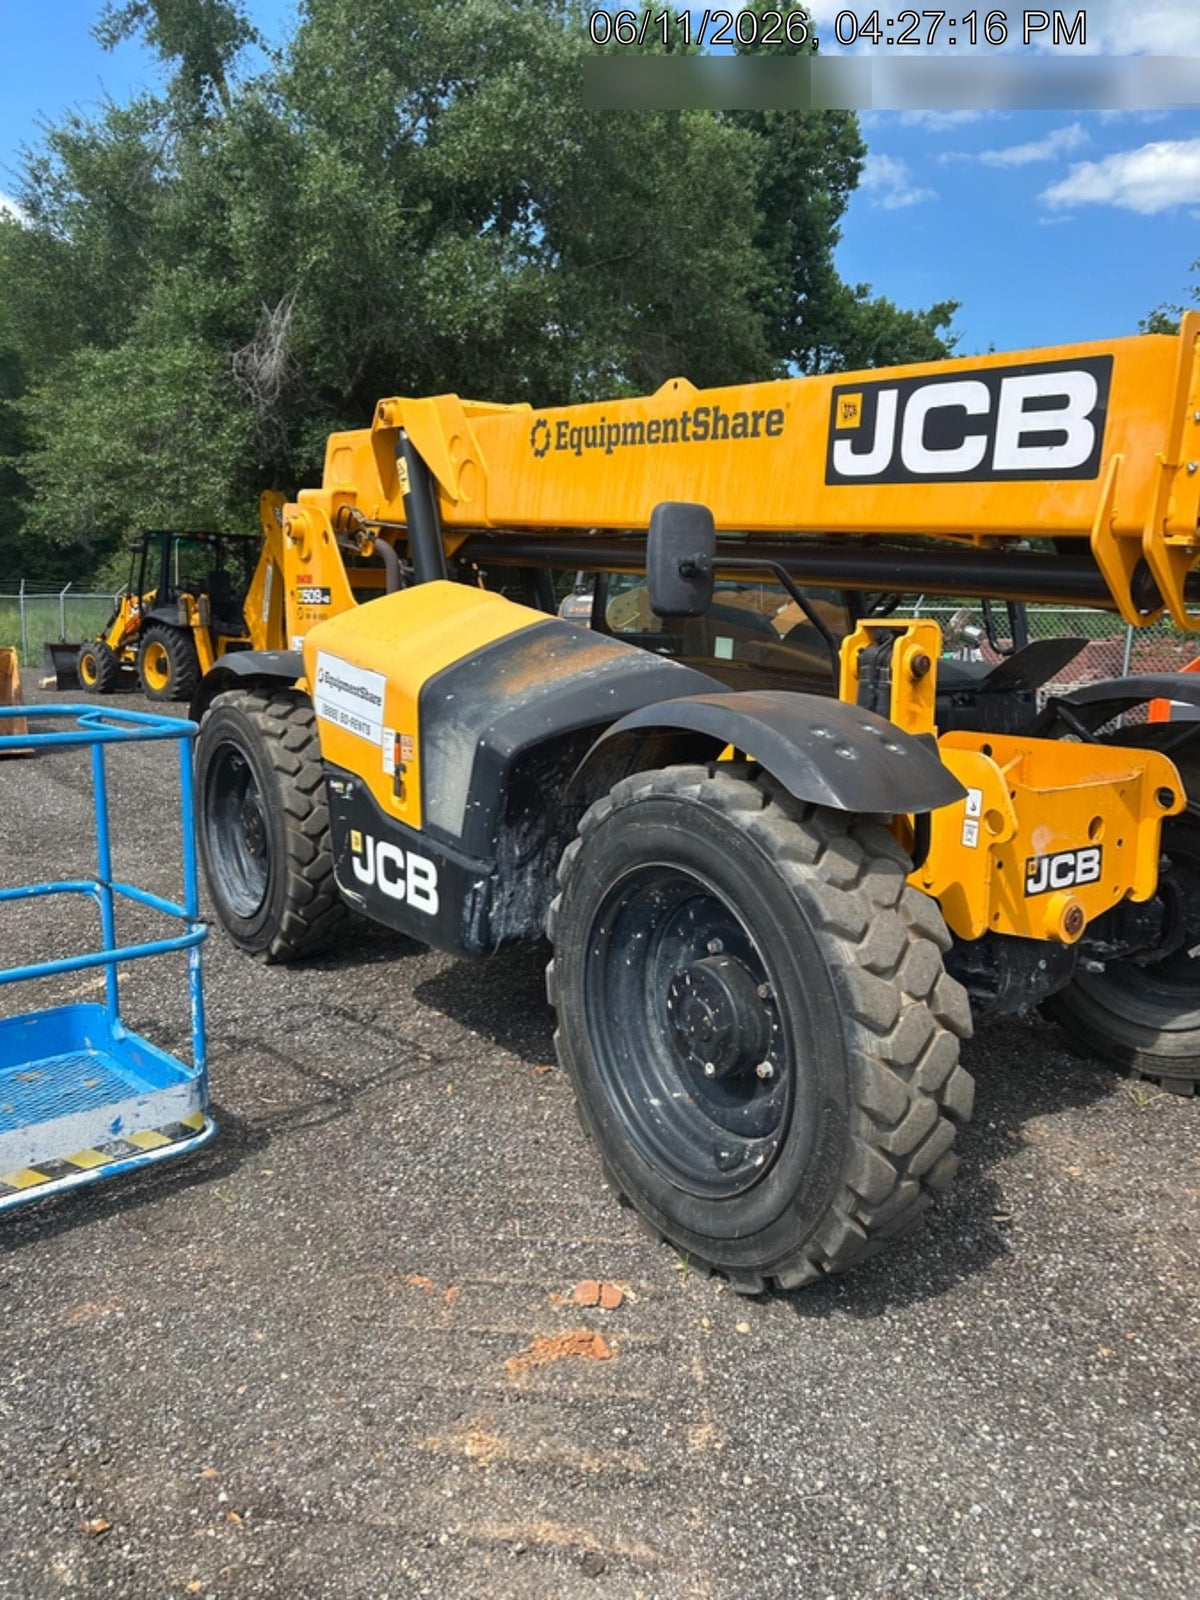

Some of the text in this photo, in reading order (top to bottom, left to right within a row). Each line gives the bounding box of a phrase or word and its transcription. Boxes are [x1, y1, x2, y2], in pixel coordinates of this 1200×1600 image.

[555, 405, 785, 456] EquipmentShare
[833, 371, 1098, 475] JCB
[352, 834, 439, 916] JCB
[1027, 848, 1100, 894] JCB
